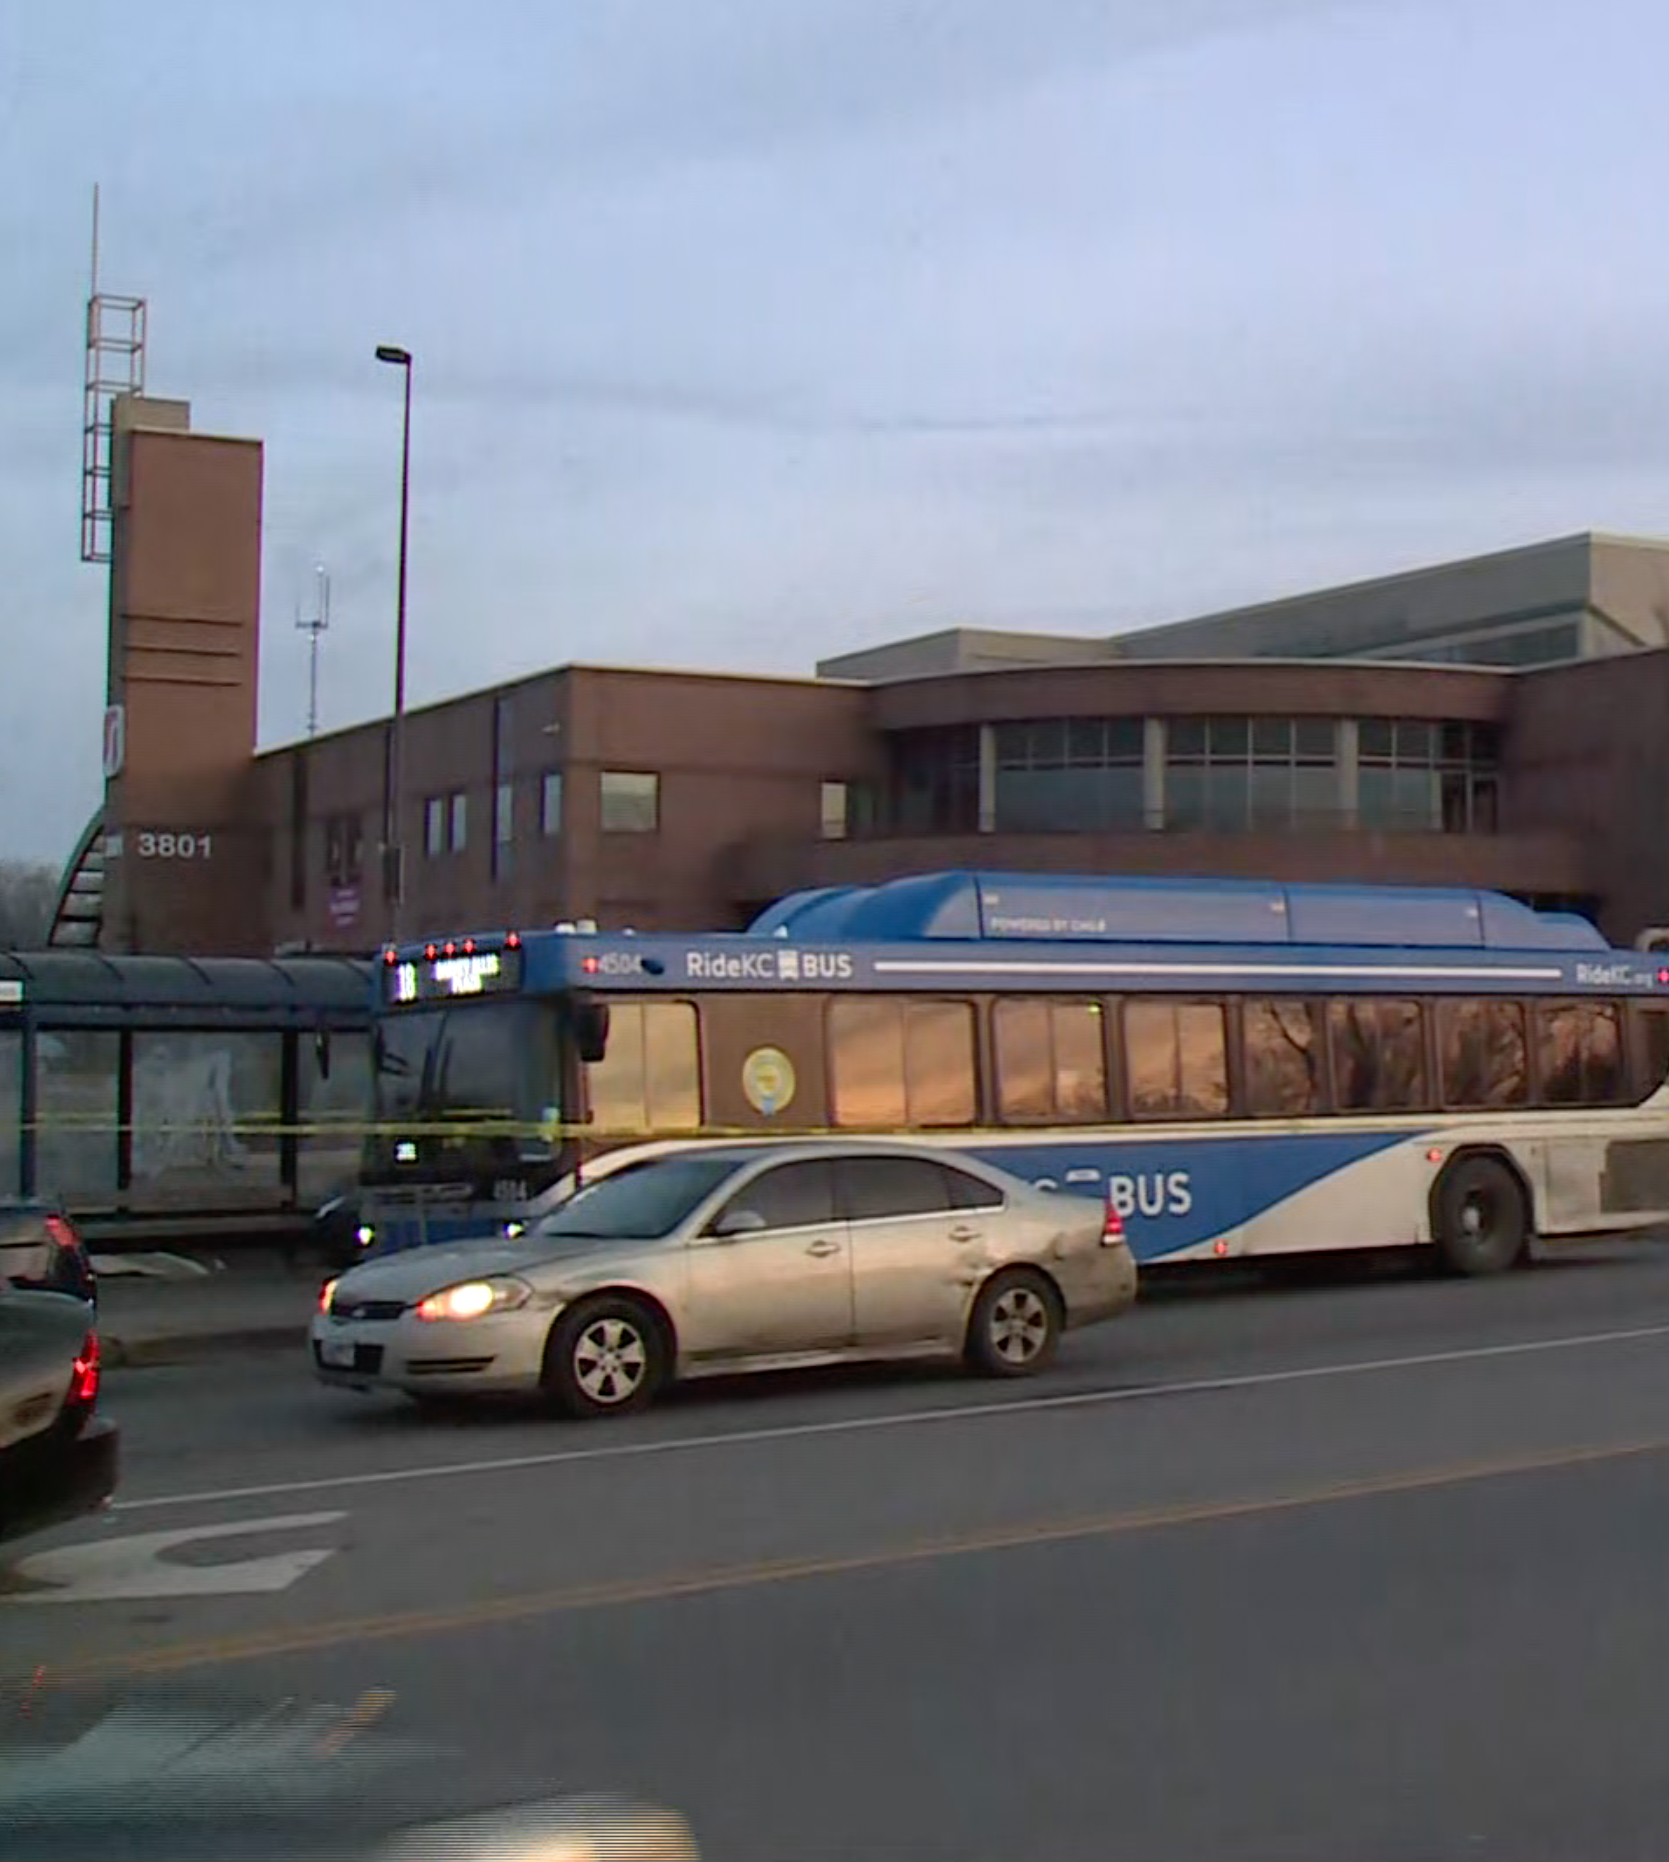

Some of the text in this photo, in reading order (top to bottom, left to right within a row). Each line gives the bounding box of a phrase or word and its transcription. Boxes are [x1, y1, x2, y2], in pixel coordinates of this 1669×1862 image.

[138, 834, 212, 860] 3801
[686, 952, 852, 978] RideKC BUS
[1109, 1171, 1193, 1218] BUS
